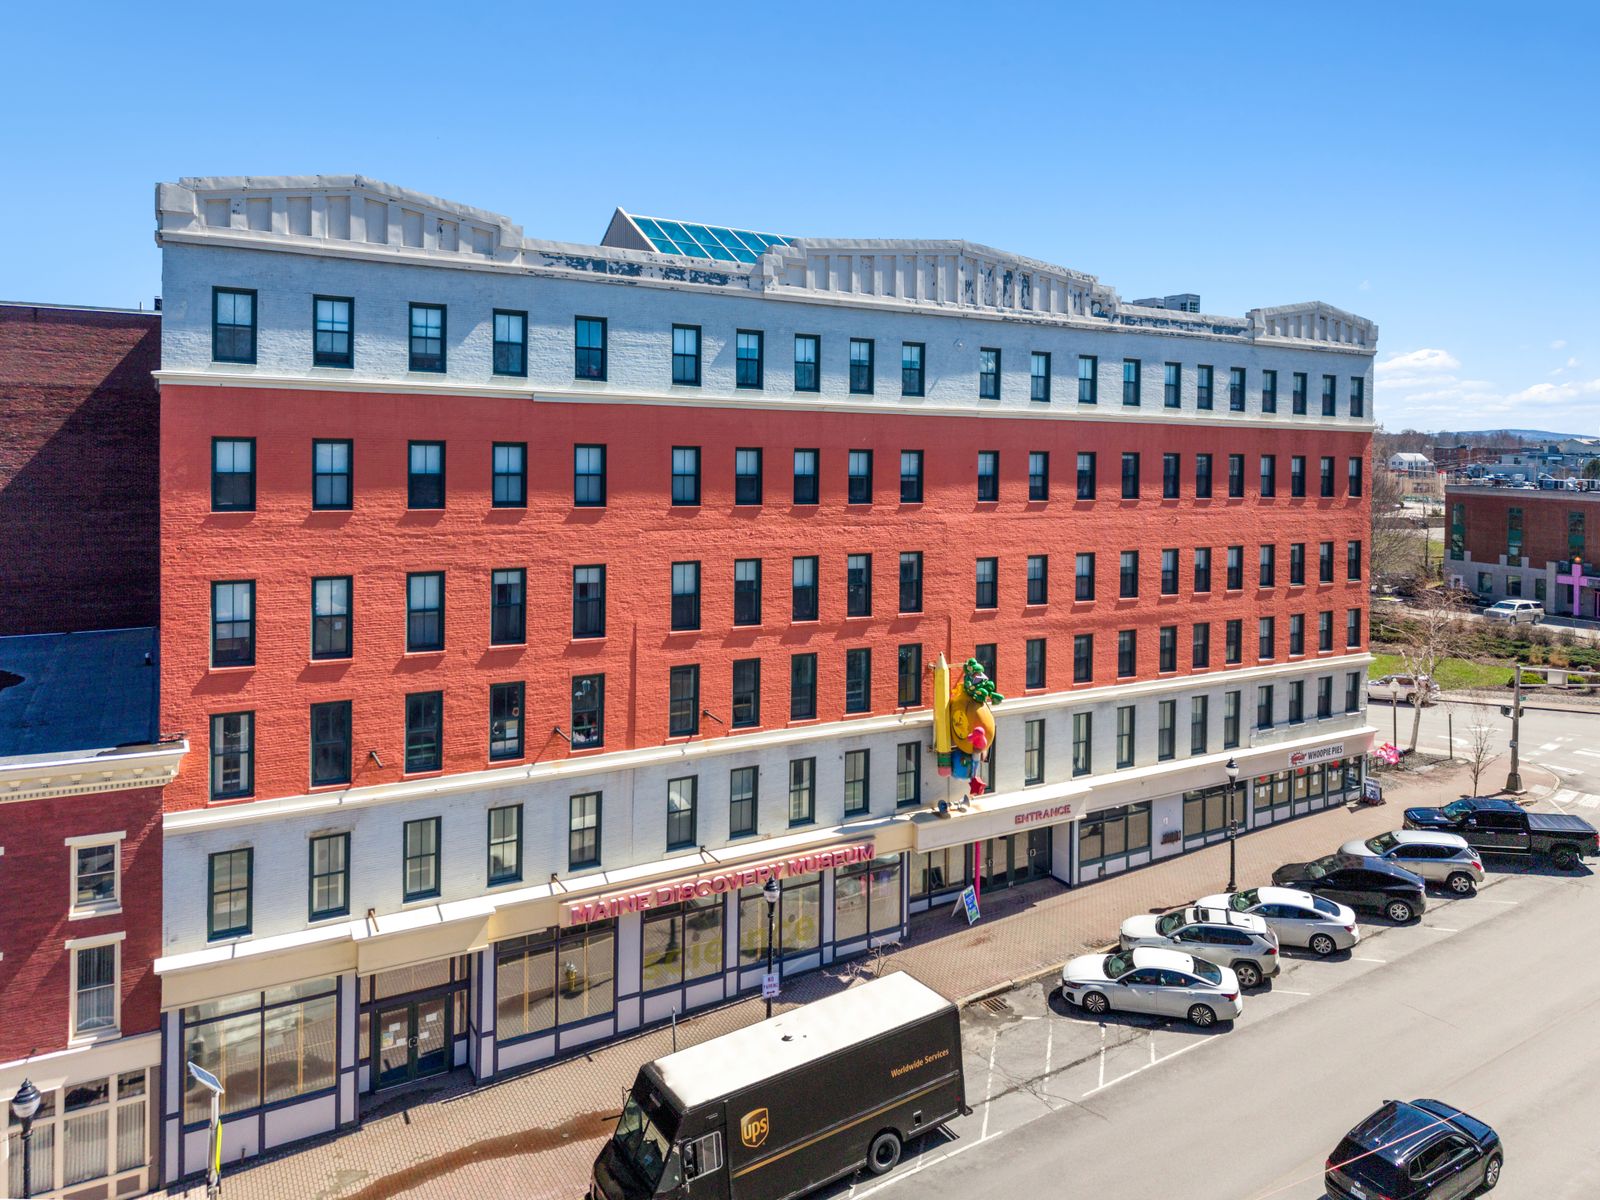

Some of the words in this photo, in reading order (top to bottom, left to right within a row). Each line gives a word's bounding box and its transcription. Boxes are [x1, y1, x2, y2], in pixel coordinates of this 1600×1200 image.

[1307, 747, 1331, 760] WHOOPIE
[1332, 745, 1343, 755] PIES
[1014, 804, 1071, 824] ENTRANCE
[571, 891, 653, 925] MAINE
[656, 862, 785, 906] DISCOVERY
[788, 843, 875, 877] MUSEUM
[890, 1059, 924, 1078] Worldwide
[924, 1048, 950, 1065] Services
[743, 1117, 767, 1142] ups
